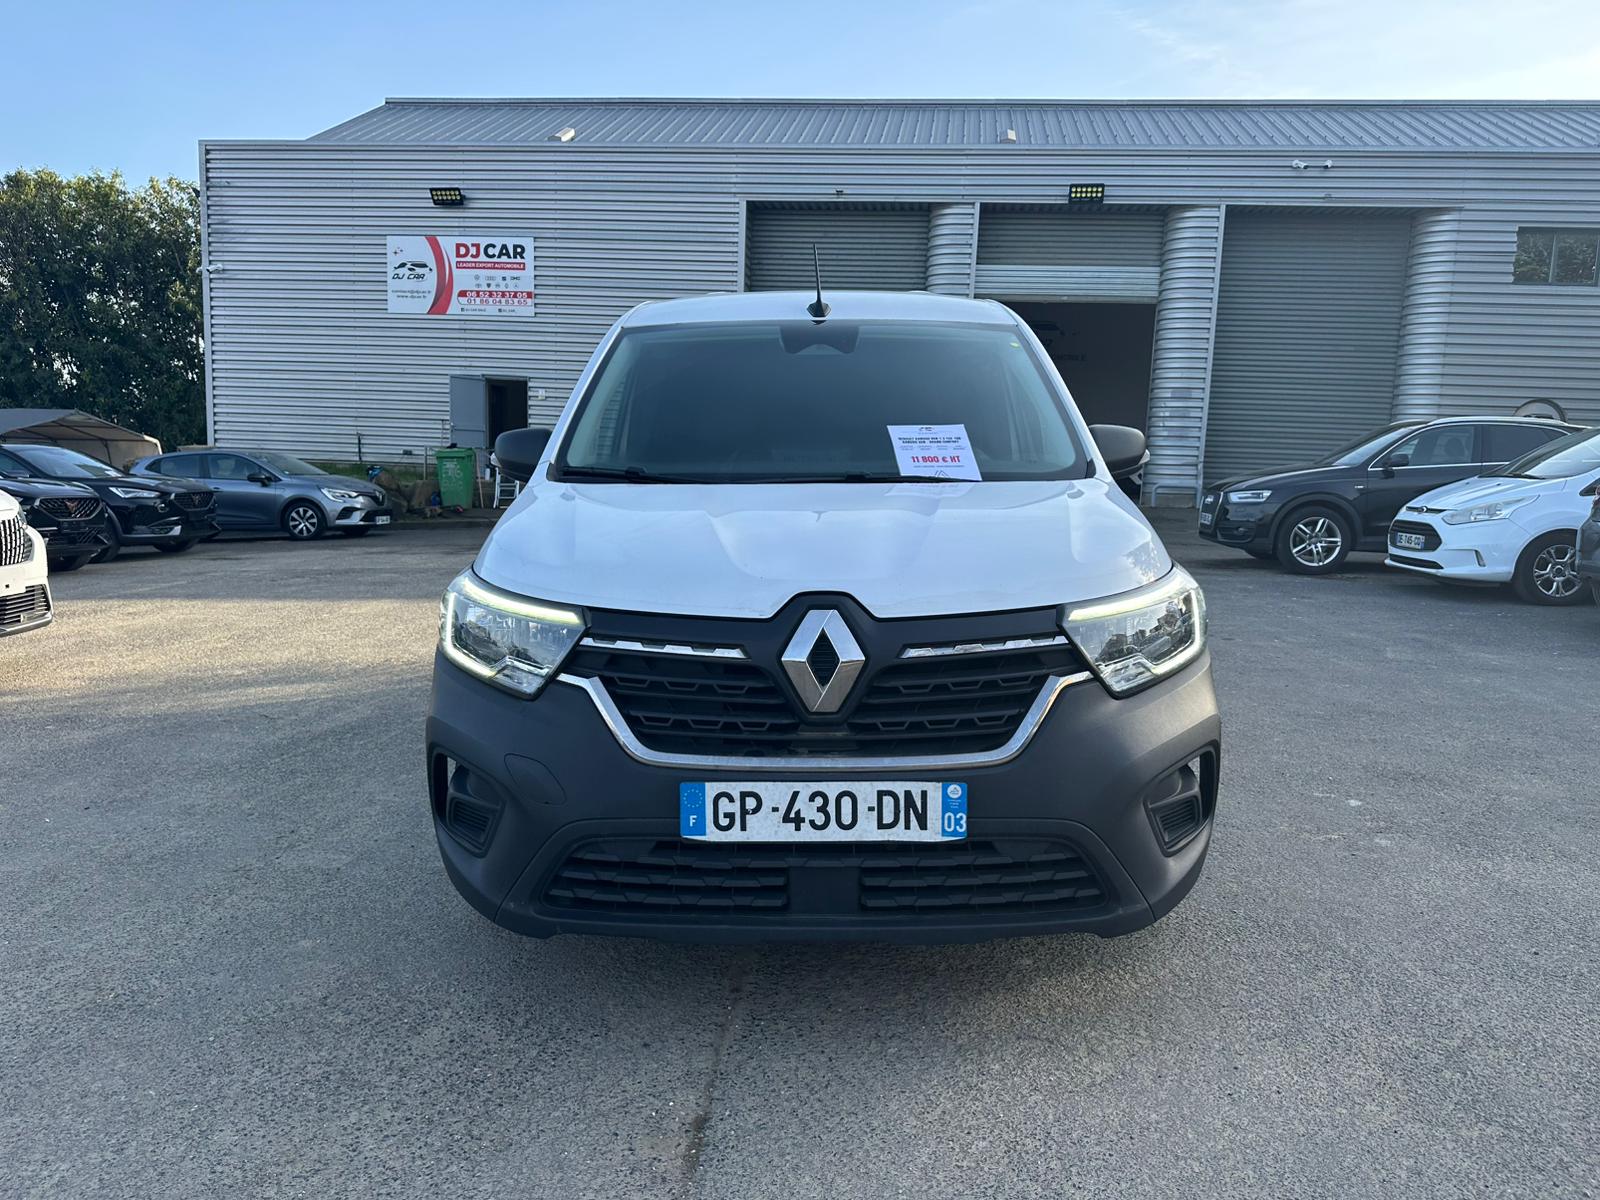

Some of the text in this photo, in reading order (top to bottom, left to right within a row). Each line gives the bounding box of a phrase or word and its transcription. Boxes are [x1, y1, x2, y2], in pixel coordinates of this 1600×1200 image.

[455, 242, 526, 260] DJ CAR
[911, 455, 920, 463] 11
[950, 455, 961, 463] HT
[689, 815, 697, 827] F
[943, 812, 967, 832] 03
